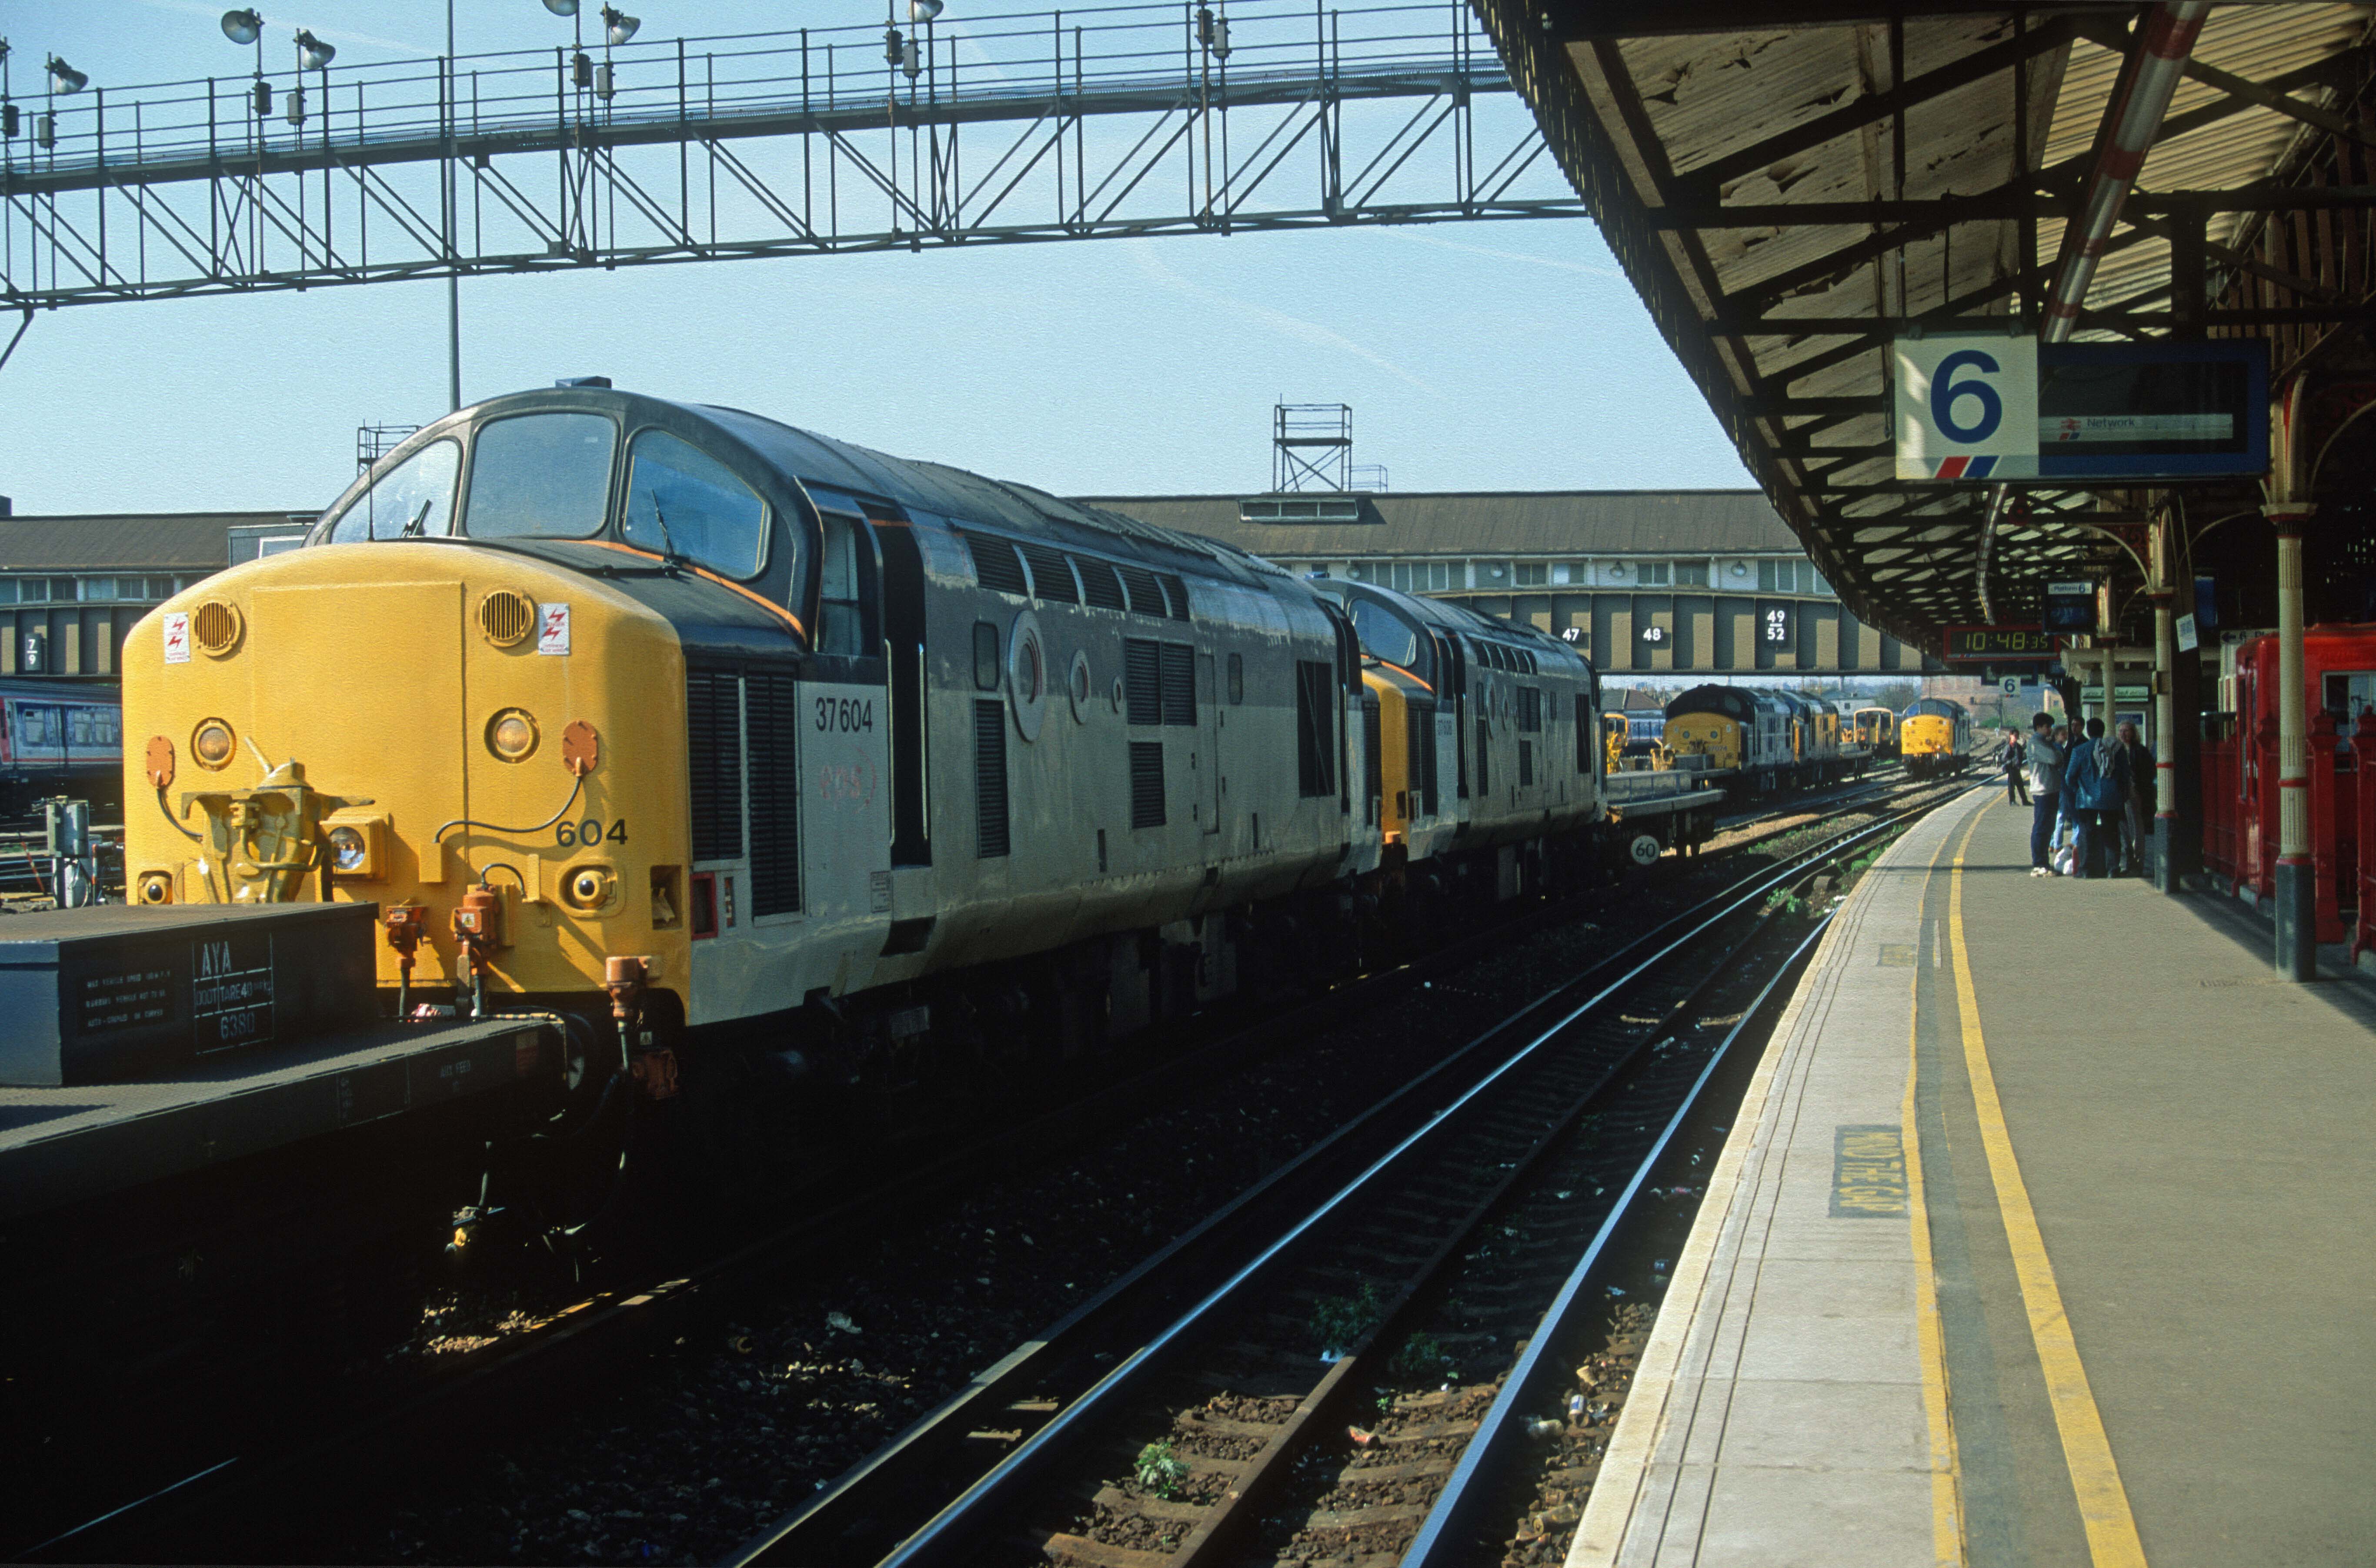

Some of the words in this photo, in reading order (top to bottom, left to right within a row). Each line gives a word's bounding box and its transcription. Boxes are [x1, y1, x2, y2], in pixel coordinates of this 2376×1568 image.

[1930, 349, 2002, 444] 6
[2087, 417, 2135, 428] Network
[2079, 583, 2086, 593] 6
[1767, 610, 1785, 623] 49
[1562, 628, 1580, 641] 47
[1643, 628, 1662, 641] 48
[1767, 627, 1785, 640] 52
[28, 639, 35, 649] 7
[29, 654, 36, 665] 9
[2004, 678, 2016, 693] 6
[816, 696, 872, 732] 37604
[556, 819, 628, 847] 604
[1635, 842, 1656, 858] 60
[202, 940, 232, 977] AYA
[220, 983, 240, 1002] TARE
[1841, 1161, 1902, 1183] THE
[1839, 1185, 1905, 1212] GAP
